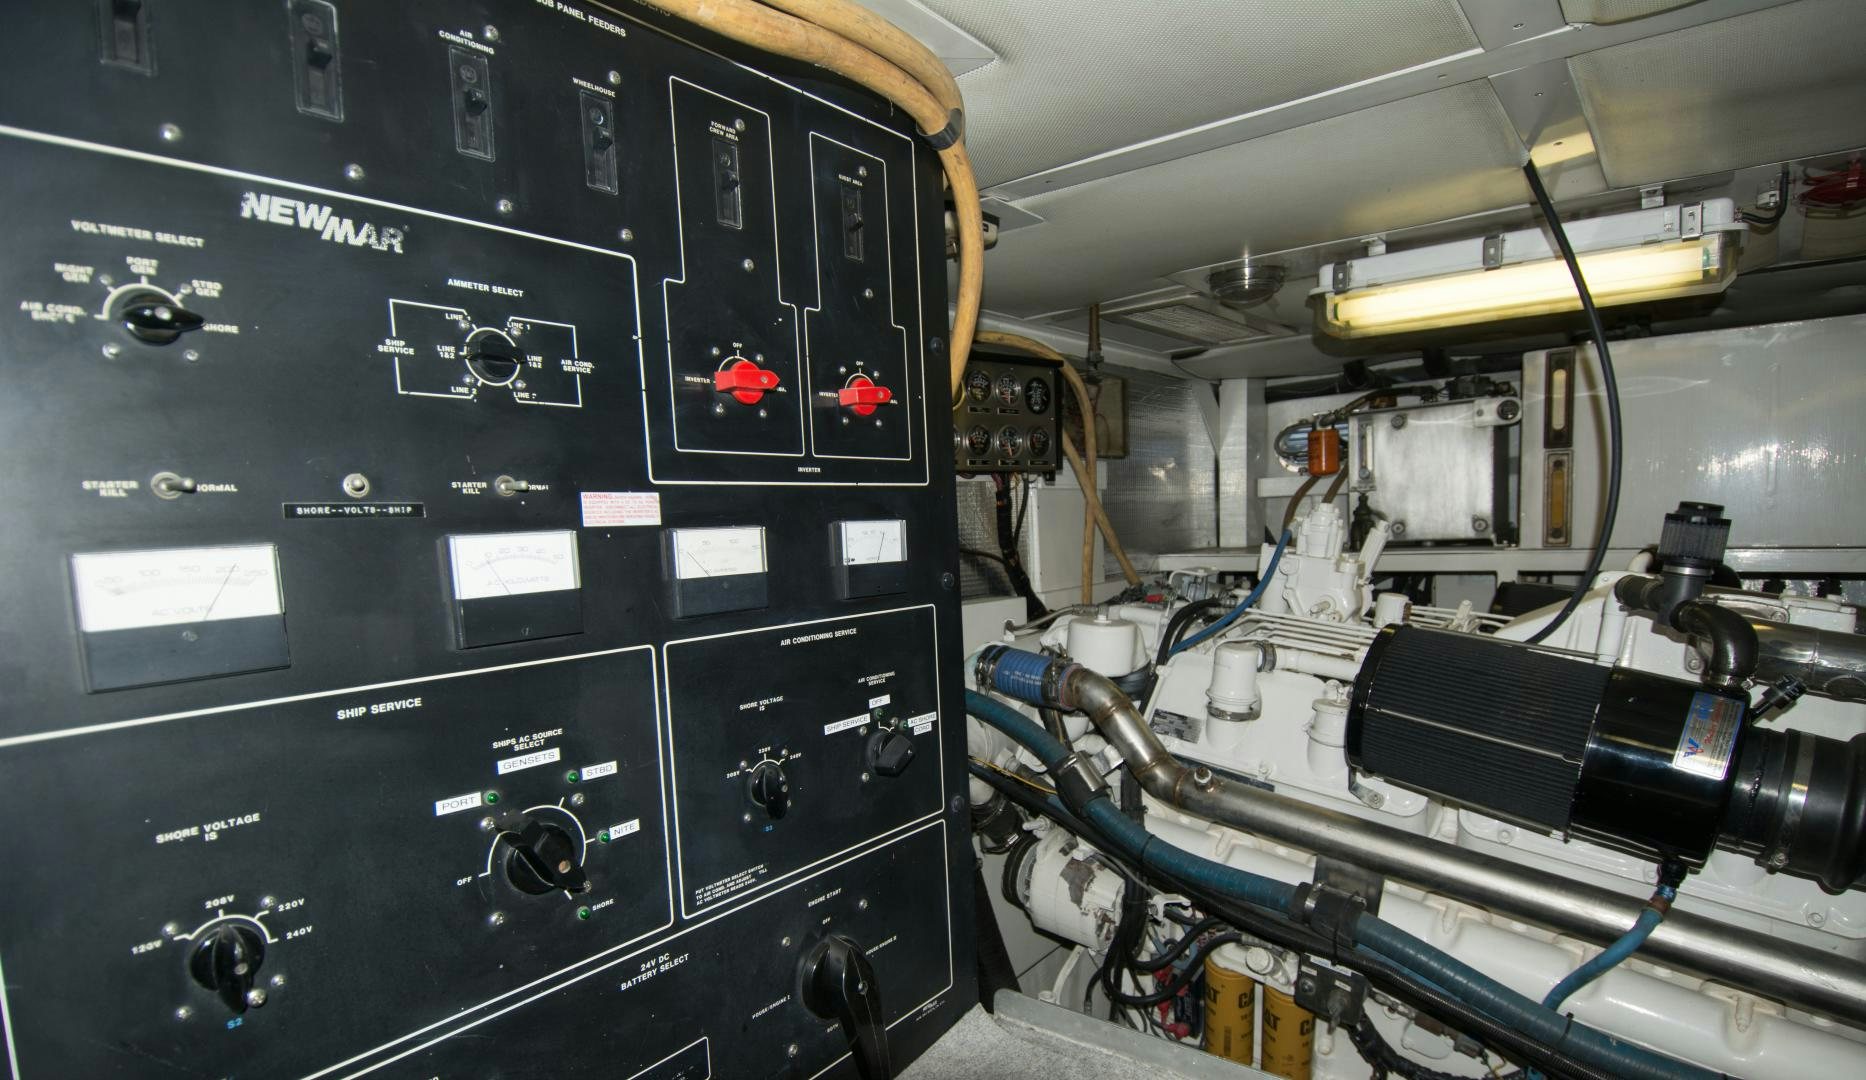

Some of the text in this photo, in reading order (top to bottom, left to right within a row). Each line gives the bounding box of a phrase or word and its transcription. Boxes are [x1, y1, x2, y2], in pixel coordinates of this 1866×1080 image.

[557, 3, 585, 20] PANEL
[588, 15, 626, 37] FEEDERS
[460, 30, 472, 38] AIR
[438, 30, 494, 54] CONDITIONING
[572, 76, 616, 98] WHEELHOUSE
[711, 120, 736, 134] FORWARD
[710, 126, 738, 142] CREW AREA
[240, 192, 404, 254] NEWMAR
[71, 220, 204, 248] VOLTMETER SELECT
[126, 256, 158, 268] PORT
[130, 264, 157, 276] GEN
[62, 272, 90, 284] GEN
[195, 287, 220, 298] GEN
[448, 279, 524, 297] AMMETER SELECT
[20, 300, 42, 311] AIR
[385, 338, 405, 347] SHIP
[378, 344, 414, 355] SERVICE
[563, 366, 591, 374] SERVICE
[452, 386, 470, 394] LINE
[82, 481, 138, 489] STARTER
[100, 488, 128, 496] KILL
[792, 633, 833, 644] CONDITIONING
[835, 628, 857, 638] SERVICE
[866, 671, 895, 681] CONDITIONING
[869, 678, 885, 686] SERVICE
[337, 698, 422, 720] SHIP SERVICE
[740, 696, 783, 711] SHORE VOLTAGE
[826, 716, 868, 733] SHIP SERVICE
[918, 714, 935, 722] SHORE
[493, 738, 516, 748] SHIPS
[532, 729, 562, 740] SOURCE
[514, 739, 544, 751] SELECT
[504, 752, 554, 769] GENSETS
[587, 764, 613, 777] STBD
[442, 796, 476, 810] PORT
[156, 813, 260, 844] SHORE VOLTAGE
[614, 823, 635, 835] NITE
[205, 831, 217, 842] IS
[457, 876, 472, 886] OFF
[732, 871, 747, 880] SELECT
[205, 894, 235, 910] 208V
[808, 888, 841, 907] ENGINE START
[278, 898, 305, 912] 220V
[592, 899, 614, 911] SHORE
[286, 926, 313, 940] 240V
[132, 940, 162, 955] 120V
[641, 953, 670, 971] 24V DC
[621, 954, 689, 990] BATTERY SELECT
[227, 1017, 243, 1029] S2
